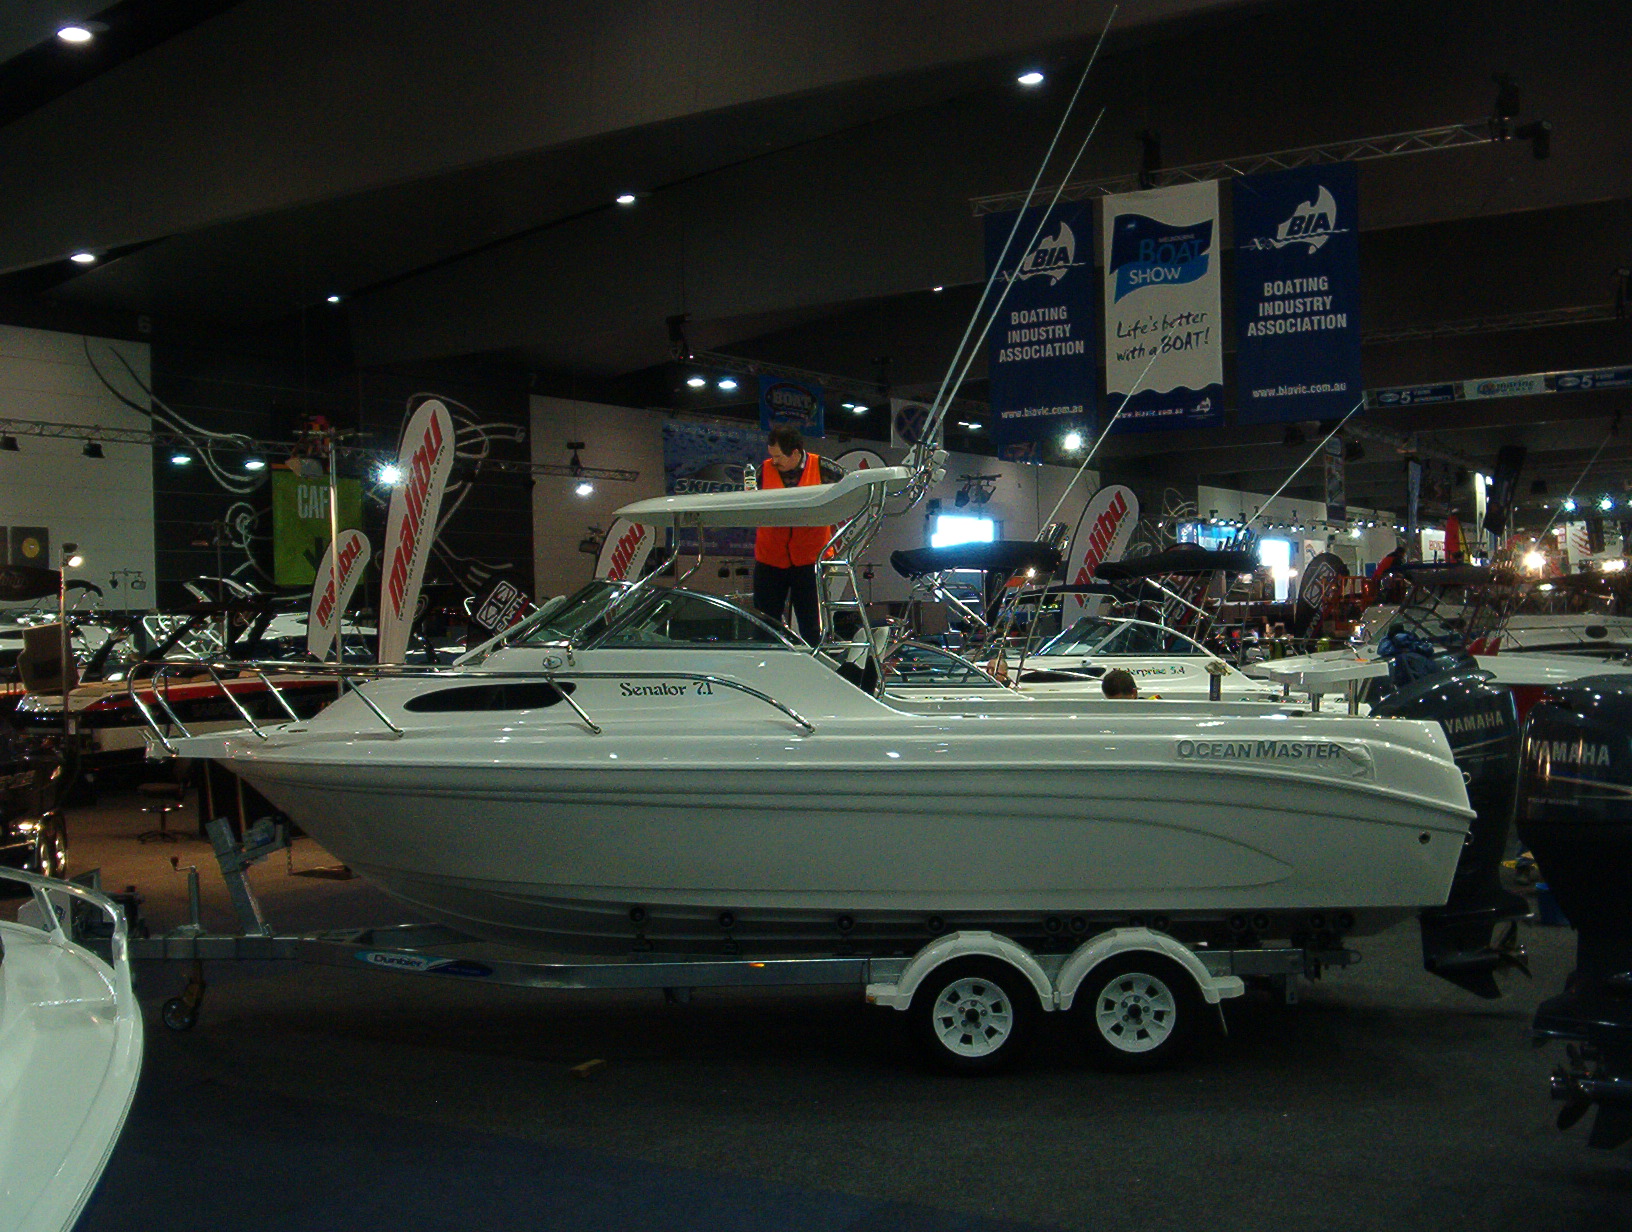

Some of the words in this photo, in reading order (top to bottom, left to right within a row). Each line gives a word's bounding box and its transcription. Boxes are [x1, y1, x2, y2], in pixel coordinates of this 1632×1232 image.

[1286, 212, 1331, 236] BIA
[1031, 246, 1071, 268] BIA
[1138, 239, 1204, 264] BOAT
[1129, 266, 1182, 285] SHOW
[1264, 276, 1329, 297] BOATING
[1011, 306, 1068, 325] BOATING
[1259, 295, 1333, 317] INDUSTRY
[1007, 323, 1072, 344] INDUSTRY
[1117, 316, 1158, 339] Life's
[1162, 311, 1208, 331] better
[1247, 313, 1348, 336] ASSOCIATION
[1000, 340, 1084, 363] ASSOCIATION
[1117, 343, 1146, 361] with
[1149, 346, 1157, 356] a
[1161, 327, 1210, 354] BOAT!
[388, 409, 443, 619] malibu
[619, 682, 687, 697] Senator
[692, 681, 714, 696] 7.1
[1445, 711, 1504, 735] YAMAHA
[1531, 739, 1611, 767] YAMAHA
